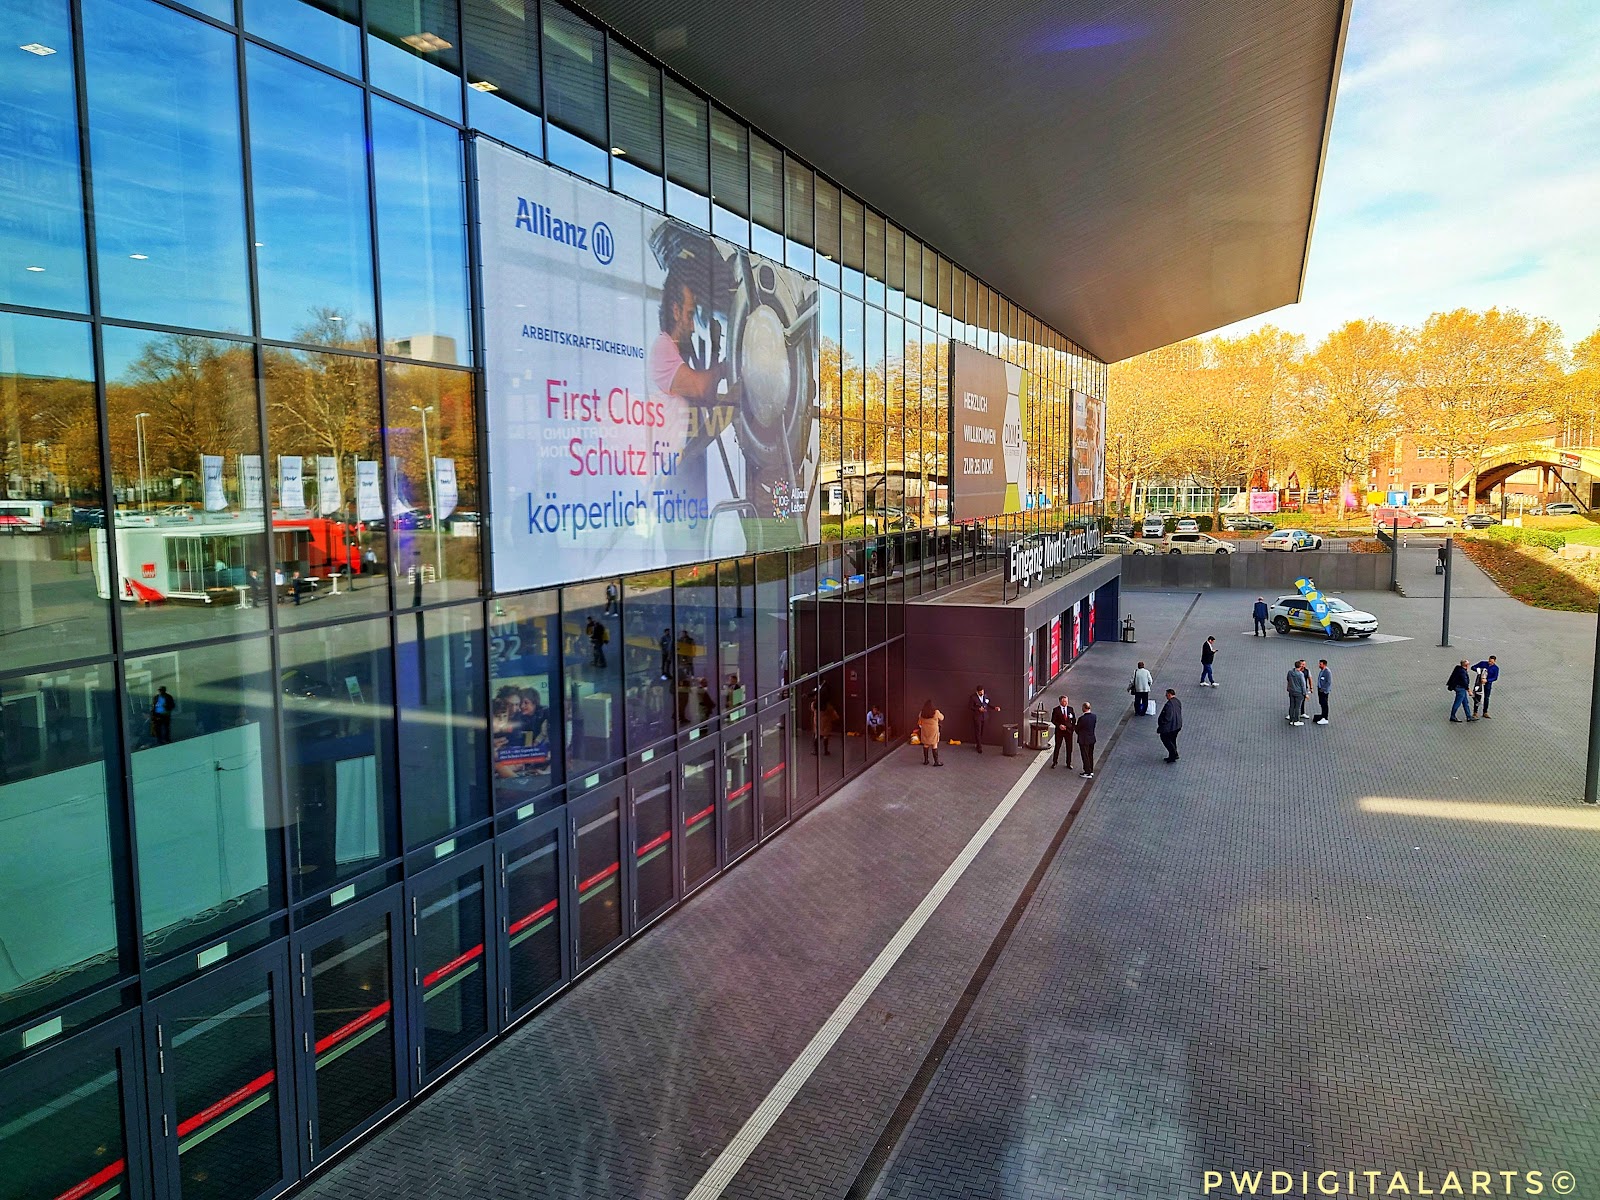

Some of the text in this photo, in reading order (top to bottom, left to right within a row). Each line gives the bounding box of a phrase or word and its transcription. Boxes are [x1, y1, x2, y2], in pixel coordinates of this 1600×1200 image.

[515, 196, 588, 251] Allianz
[522, 324, 644, 359] ARBEITSKRAFTSICHERUNG
[546, 379, 665, 428] First Class
[963, 391, 988, 413] HERZLICH
[963, 424, 996, 445] WILLKOMMEN
[569, 437, 680, 476] Schutz für
[963, 457, 974, 475] ZUR
[528, 490, 713, 540] körperlich Tätige.
[1010, 541, 1044, 588] Eingang
[1044, 531, 1061, 569] Nord
